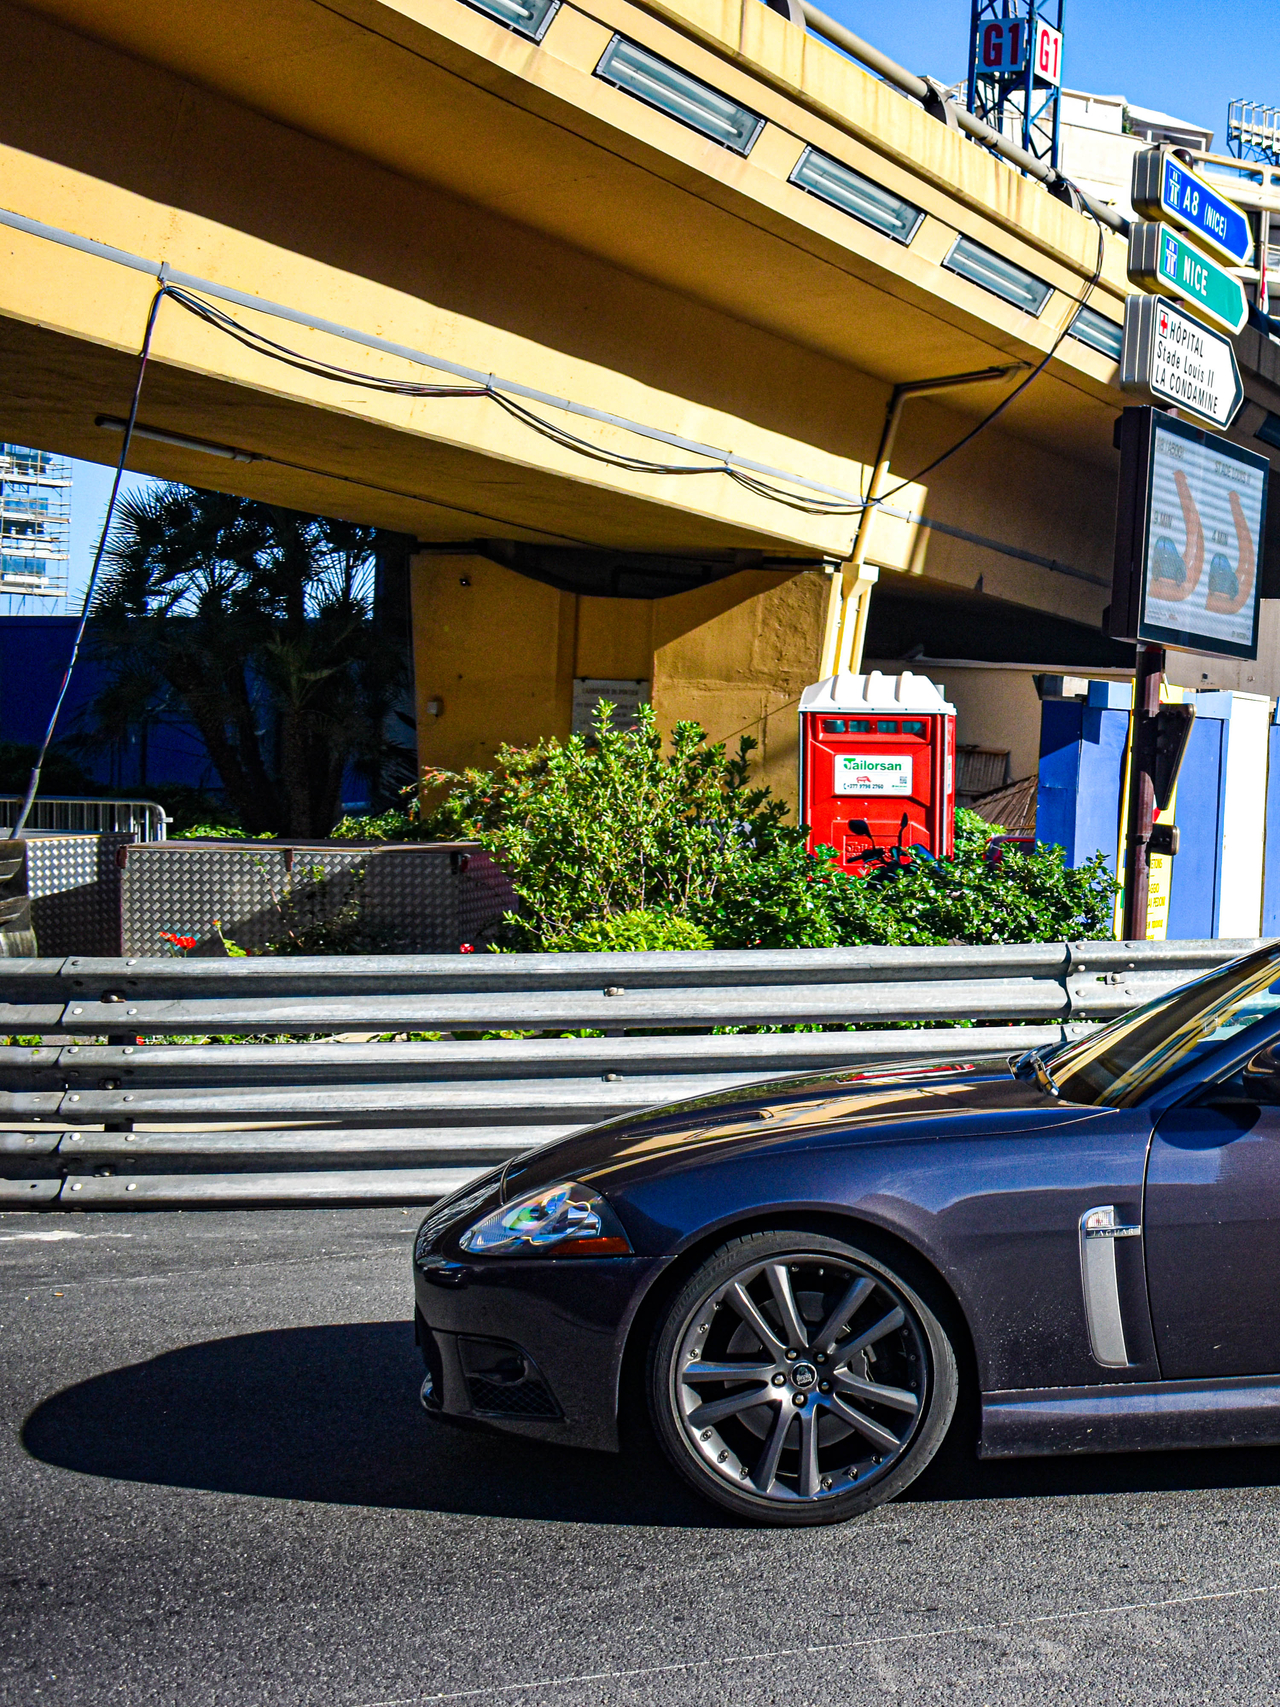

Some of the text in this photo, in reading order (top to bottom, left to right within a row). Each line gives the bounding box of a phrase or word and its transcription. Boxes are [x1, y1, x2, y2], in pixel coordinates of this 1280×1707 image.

[983, 23, 1020, 67] G1
[1039, 28, 1059, 78] G1
[1183, 186, 1227, 239] A8 (NICE)
[1183, 255, 1209, 297] NICE
[1169, 320, 1204, 358] HÔPITAL
[1157, 340, 1180, 369] Stade
[1183, 355, 1205, 383] Louis
[1155, 364, 1219, 414] LA CONDAMINE
[843, 757, 902, 771] Tailorsan
[1093, 1228, 1135, 1237] JAGUAR
